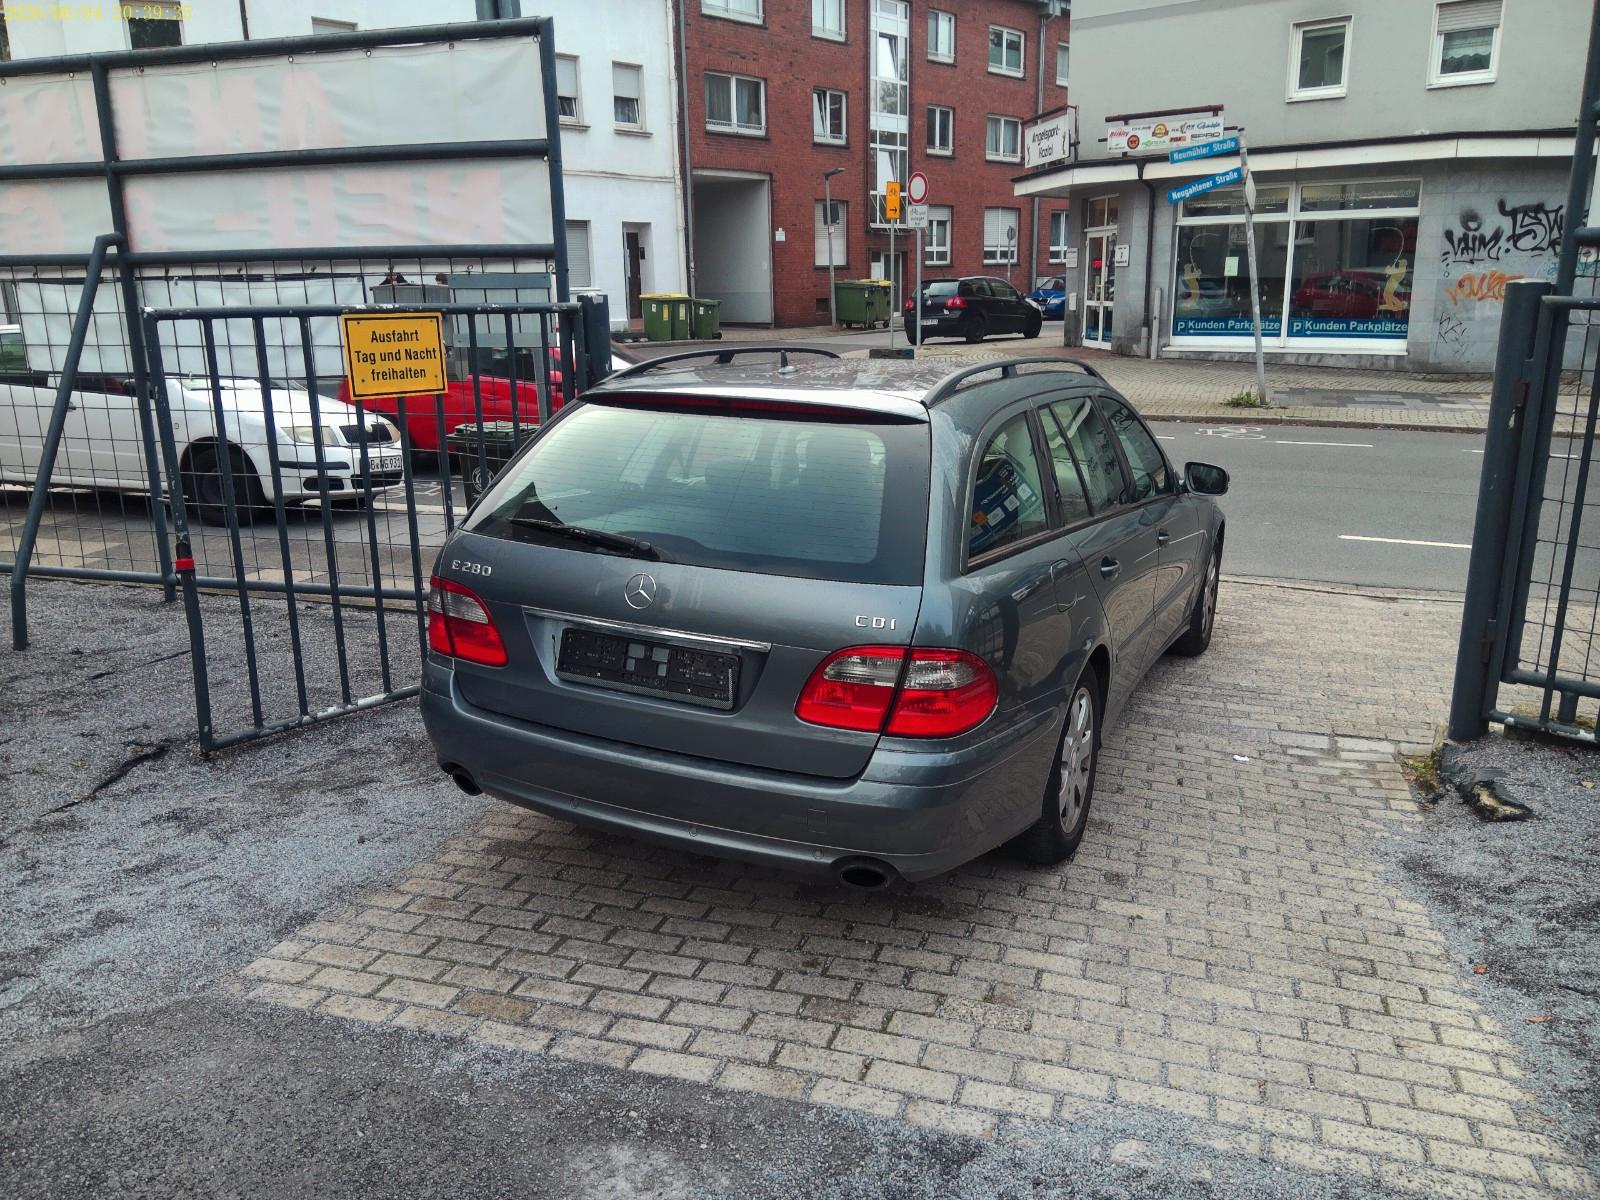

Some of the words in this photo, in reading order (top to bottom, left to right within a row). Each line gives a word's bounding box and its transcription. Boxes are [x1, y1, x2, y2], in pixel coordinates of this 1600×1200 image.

[1173, 146, 1209, 160] Neumühler
[1212, 140, 1235, 151] Straße
[1172, 180, 1213, 200] Neugahlener
[1216, 171, 1238, 184] Straße
[1188, 320, 1225, 329] Kunden
[1305, 321, 1346, 330] Kunden
[1350, 321, 1408, 332] Parkplätze
[371, 329, 420, 343] Ausfahrt
[355, 350, 376, 365] Tag
[380, 349, 401, 361] und
[405, 347, 437, 360] Nacht
[371, 367, 426, 381] freihalten
[855, 615, 897, 631] CDI
